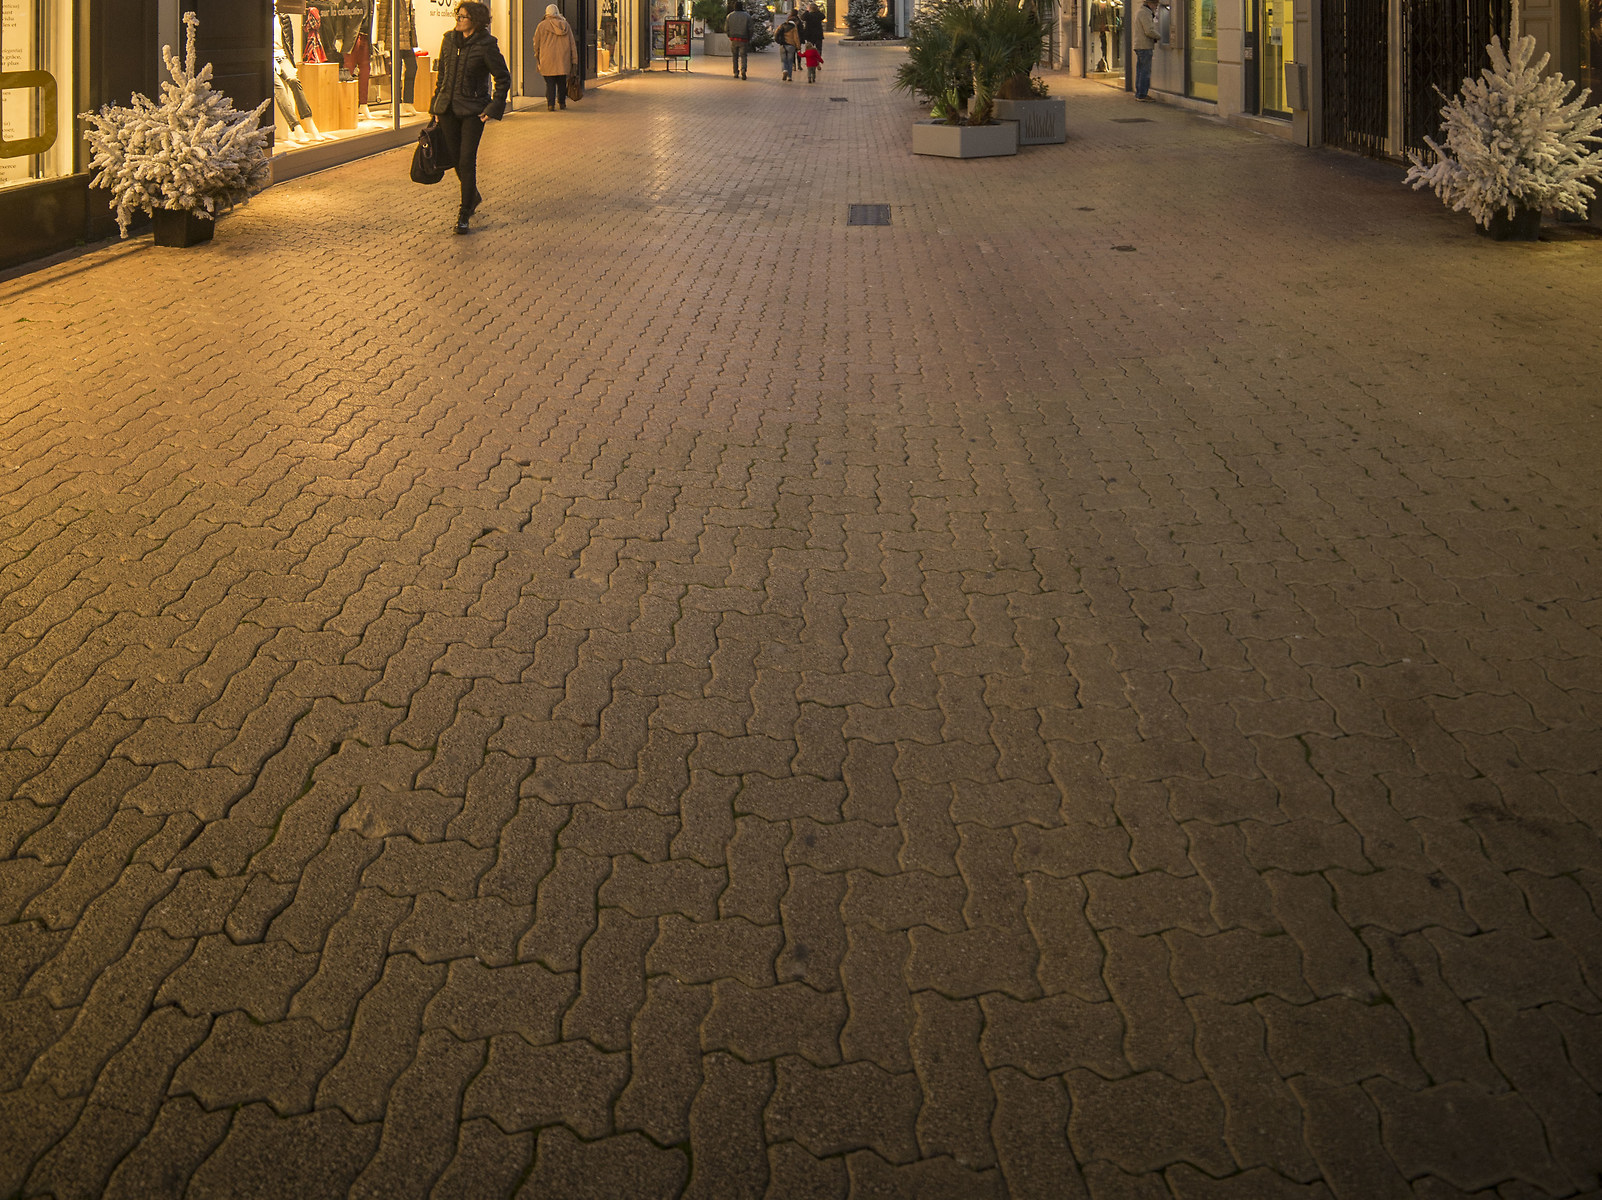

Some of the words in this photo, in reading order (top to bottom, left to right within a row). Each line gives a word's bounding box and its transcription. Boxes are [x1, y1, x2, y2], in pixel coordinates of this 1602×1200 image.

[320, 9, 330, 17] sur
[330, 5, 337, 17] la
[338, 5, 364, 16] collection
